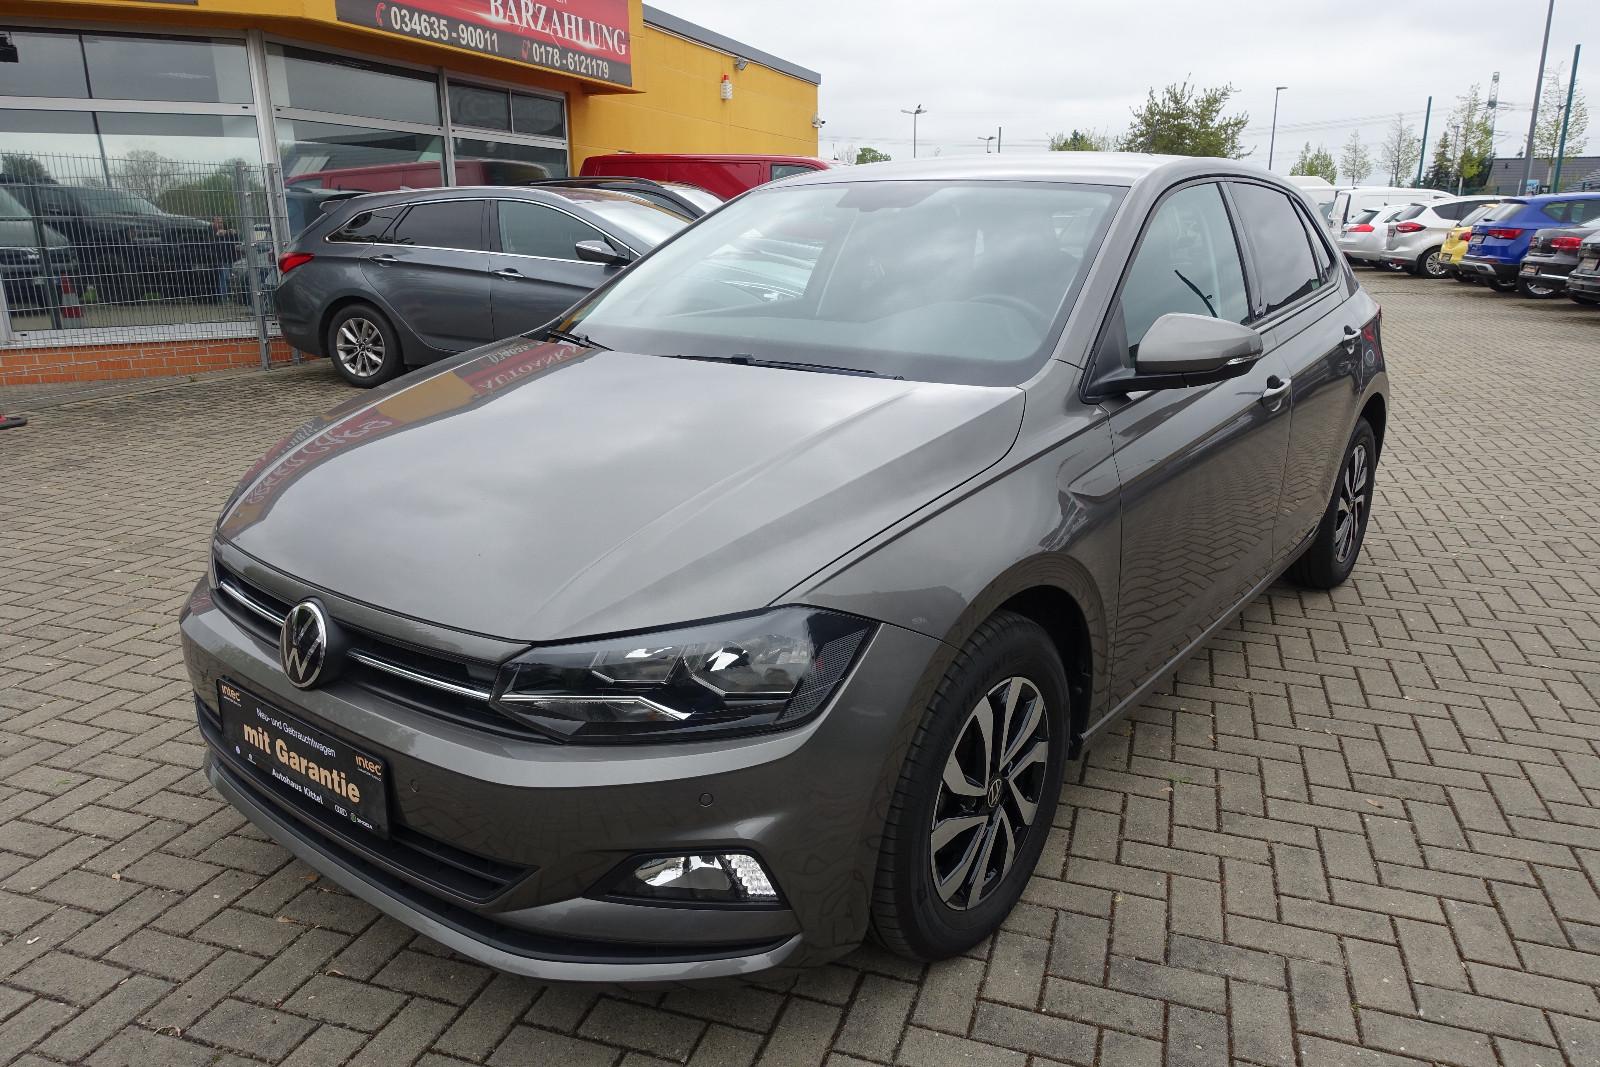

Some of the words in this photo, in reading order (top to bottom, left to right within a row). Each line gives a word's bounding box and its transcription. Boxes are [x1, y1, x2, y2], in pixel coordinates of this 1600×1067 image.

[489, 0, 627, 55] BARZAHLUNG
[243, 723, 271, 755] mit
[275, 738, 361, 803] Garantie
[271, 768, 302, 792] Autohaus
